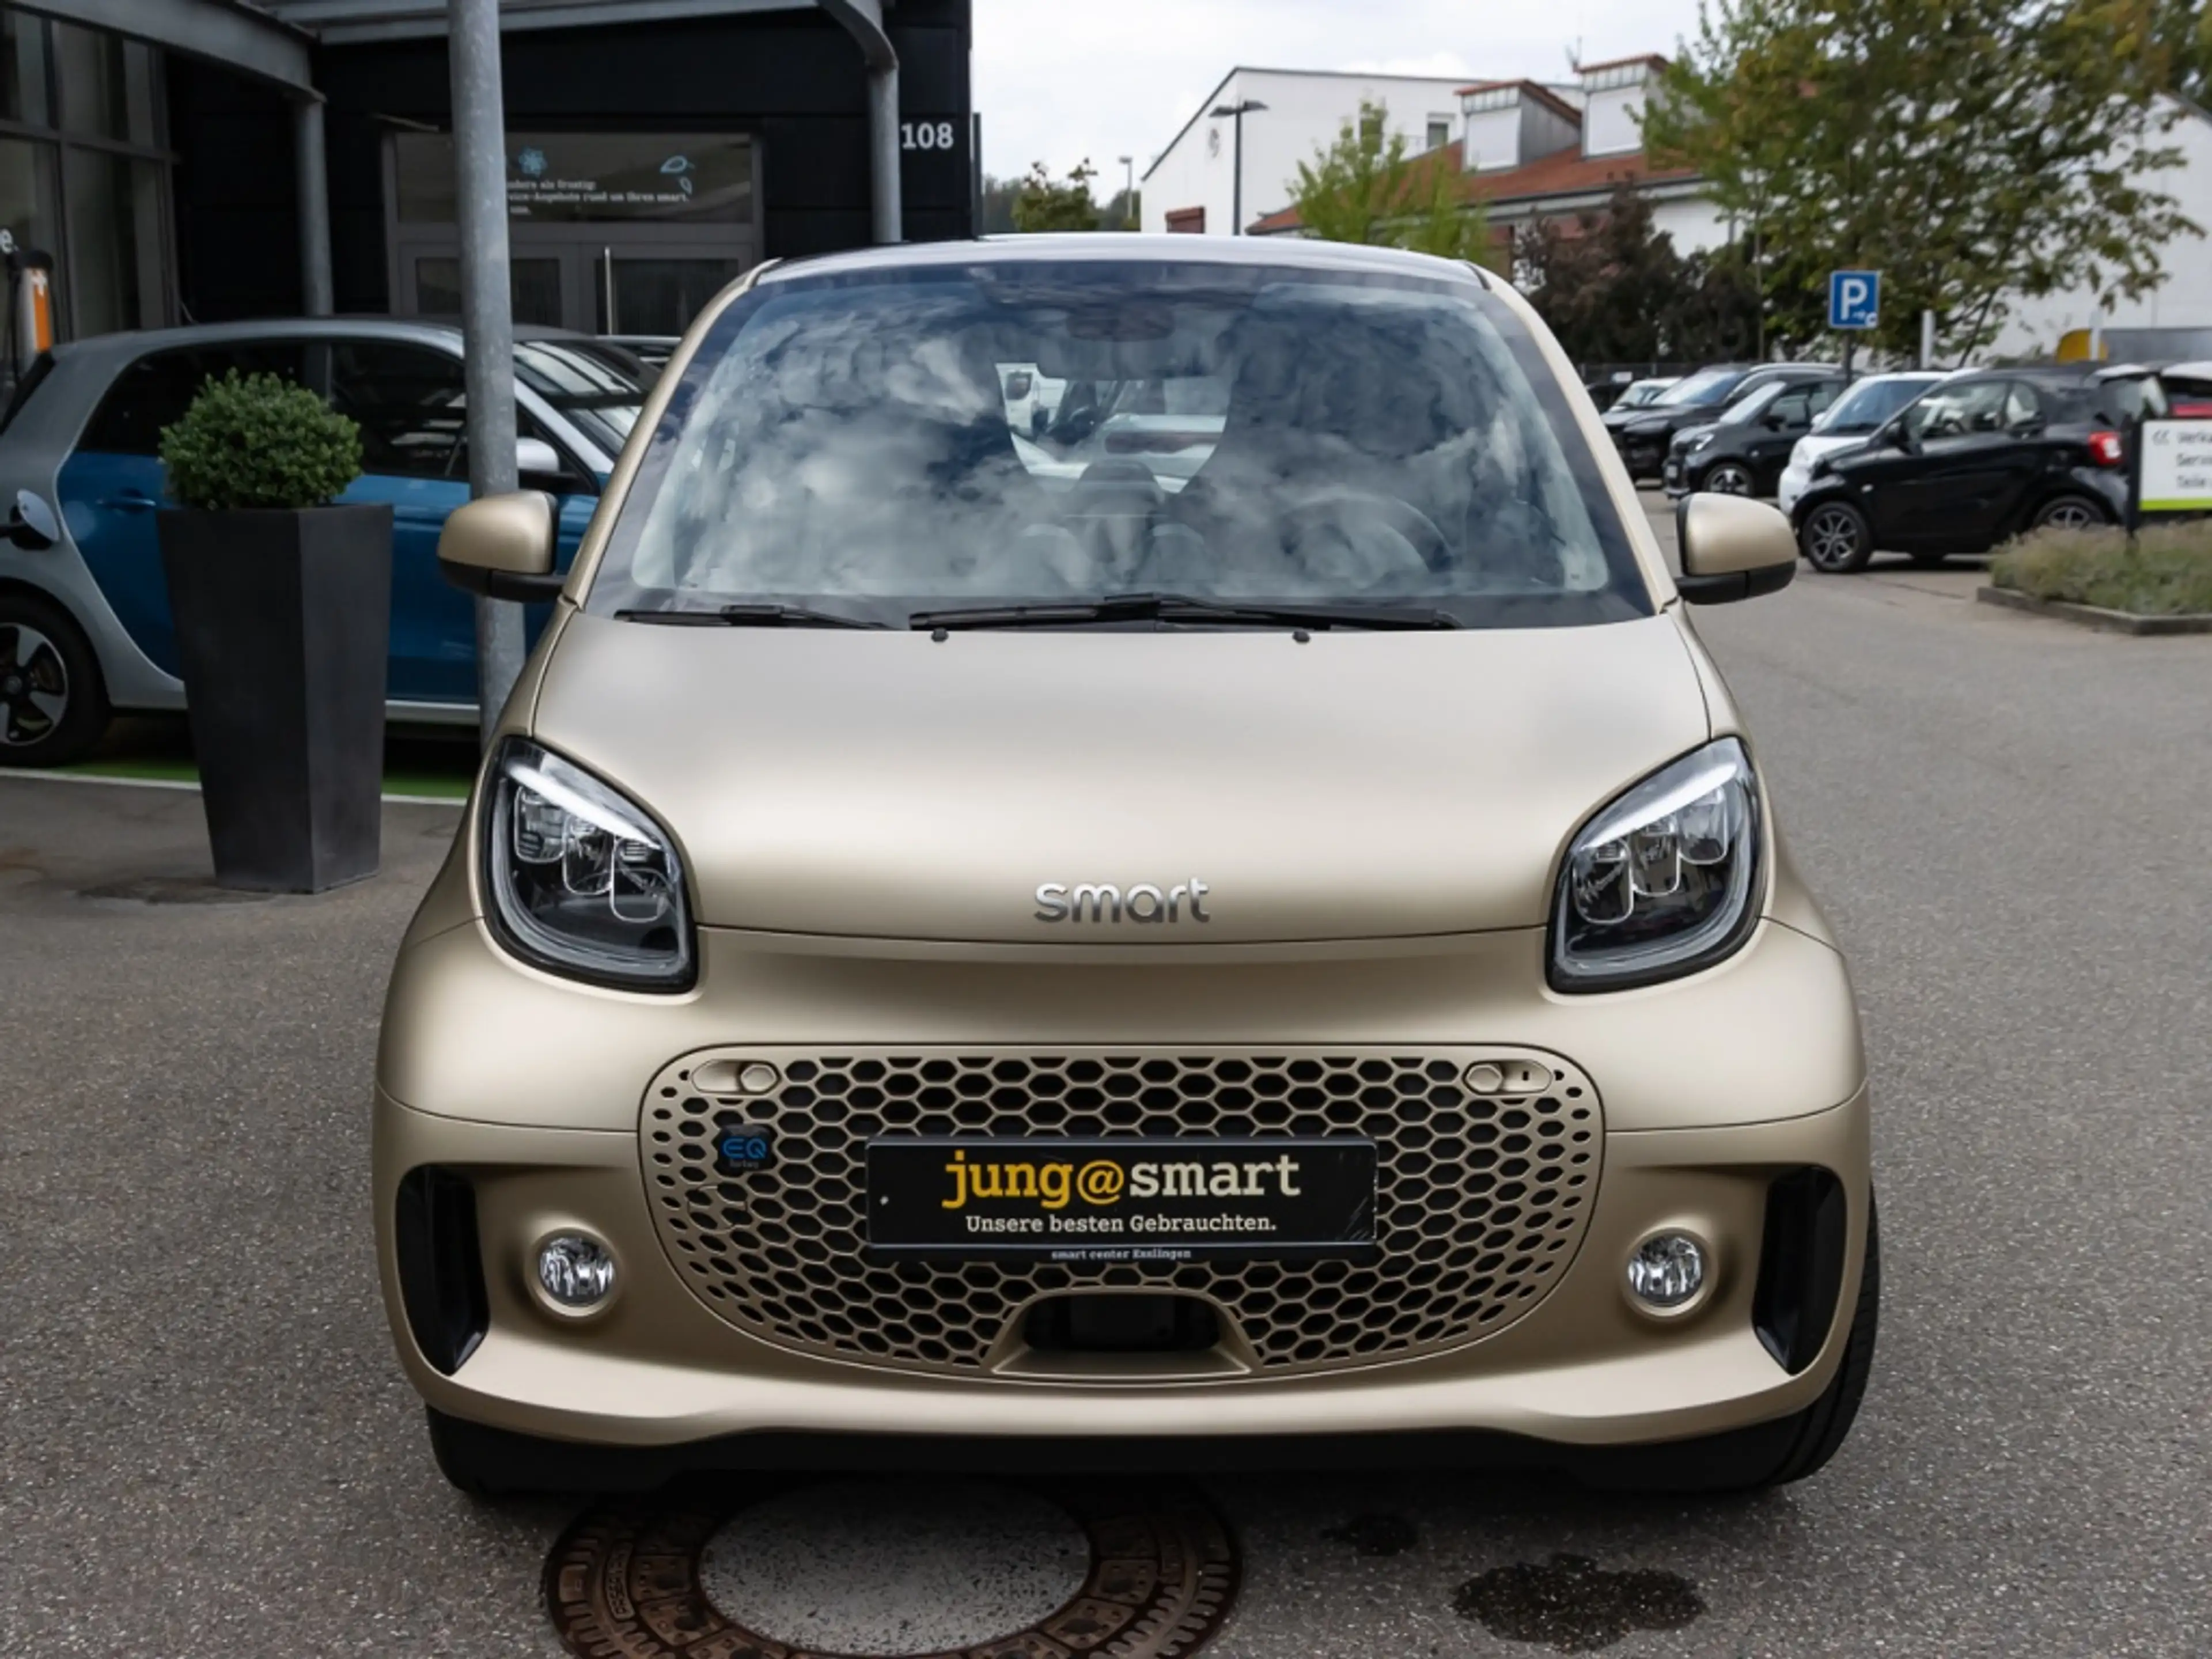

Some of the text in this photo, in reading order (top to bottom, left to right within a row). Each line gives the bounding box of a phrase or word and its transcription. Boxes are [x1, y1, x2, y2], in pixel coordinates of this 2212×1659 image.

[901, 122, 954, 149] 108
[1840, 279, 1868, 321] P
[1034, 877, 1210, 924] smart
[723, 1138, 767, 1159] EQ
[941, 1150, 1301, 1208] jung@smart
[965, 1213, 1277, 1232] Unsere besten Gebrauchten.
[1051, 1249, 1086, 1260] smart
[1089, 1249, 1131, 1259] center
